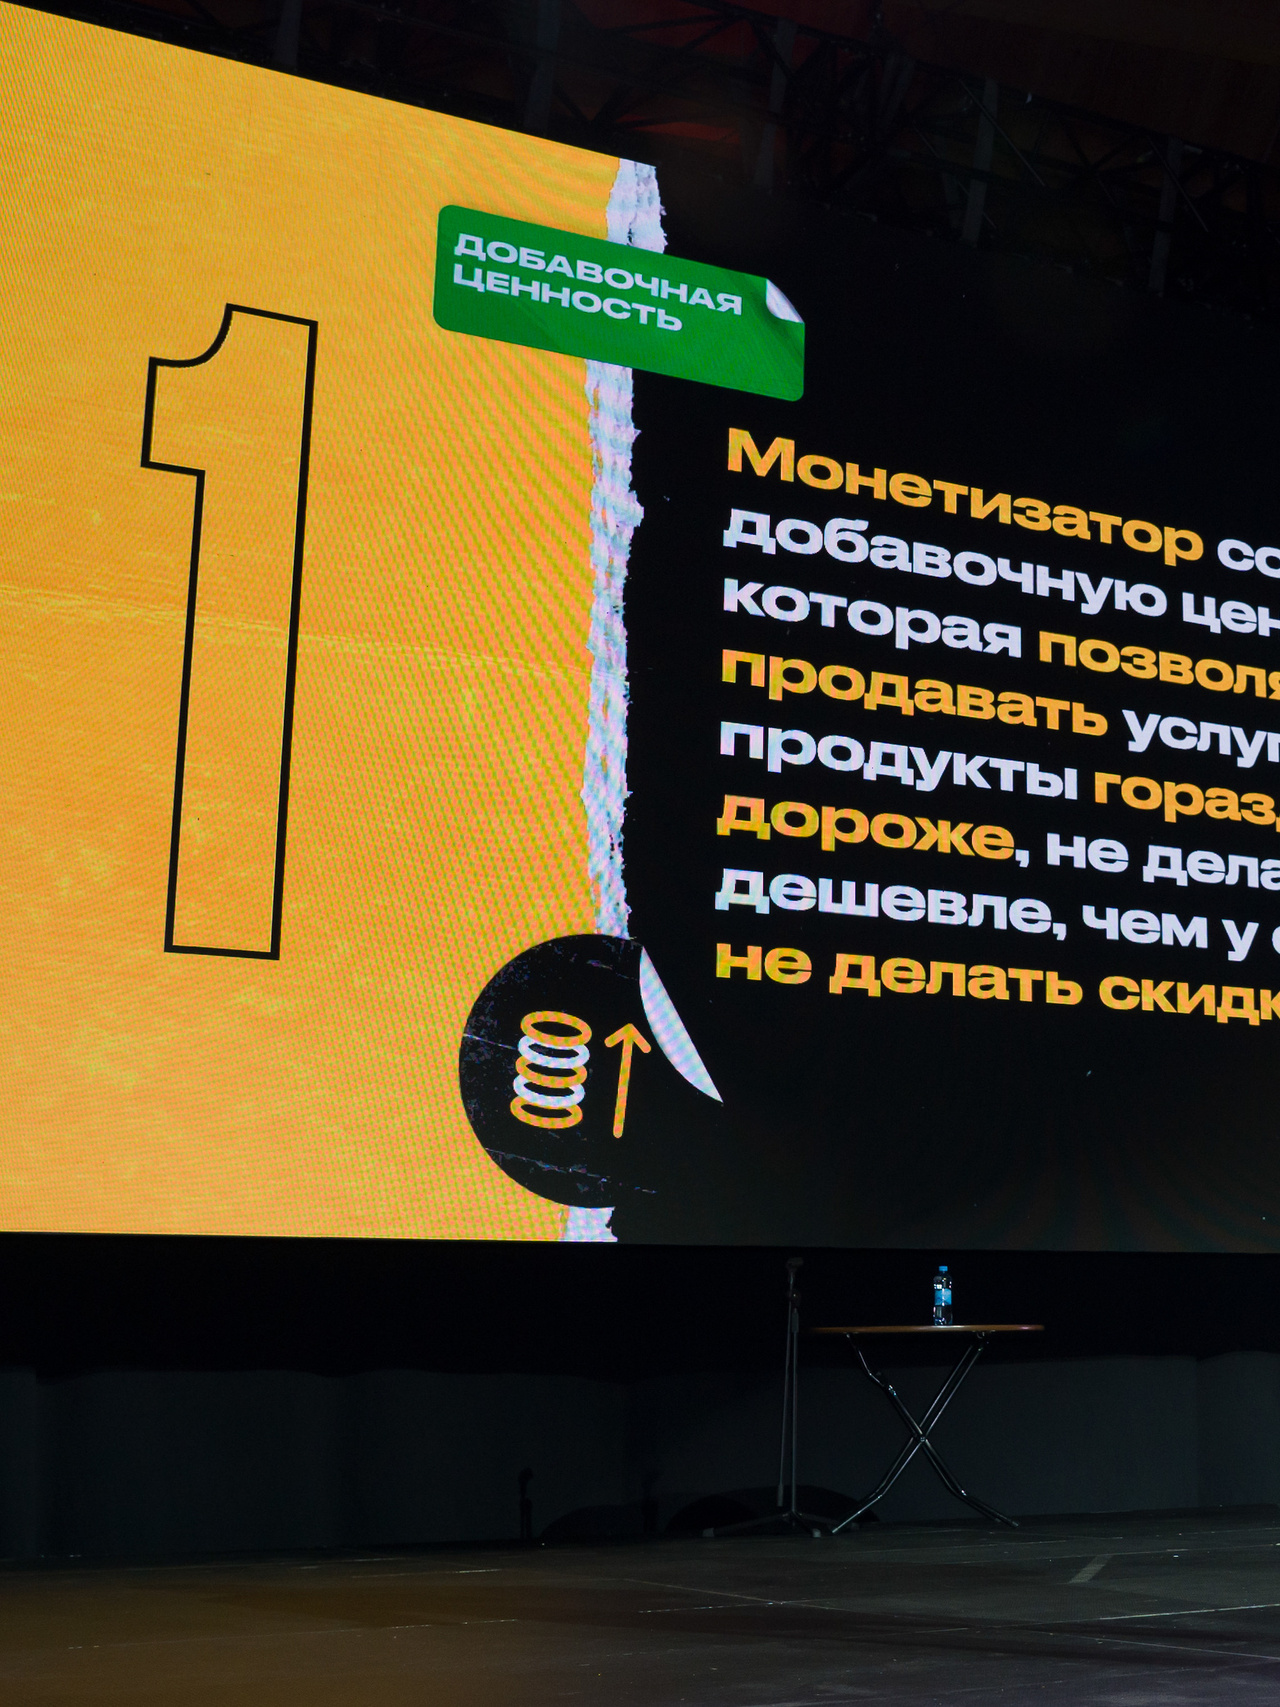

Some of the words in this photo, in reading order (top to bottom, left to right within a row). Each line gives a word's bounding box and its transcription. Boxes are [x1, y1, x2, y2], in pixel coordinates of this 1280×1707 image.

[453, 232, 744, 317] ДОБАВОЧНАЯ
[453, 263, 683, 332] ЦЕННОСТЬ
[727, 427, 1204, 567] Монетизатор
[723, 507, 1168, 617] добавочную
[140, 303, 318, 960] 1
[723, 577, 1023, 659] которая
[721, 648, 1109, 737] продавать
[719, 721, 1078, 801] продукты
[716, 794, 1030, 868] дороже,
[1047, 832, 1130, 873] не
[714, 867, 1067, 941] дешевле,
[1083, 904, 1209, 949] чем
[1221, 918, 1260, 962] у
[715, 942, 813, 985] не
[828, 953, 1084, 1006] делать
